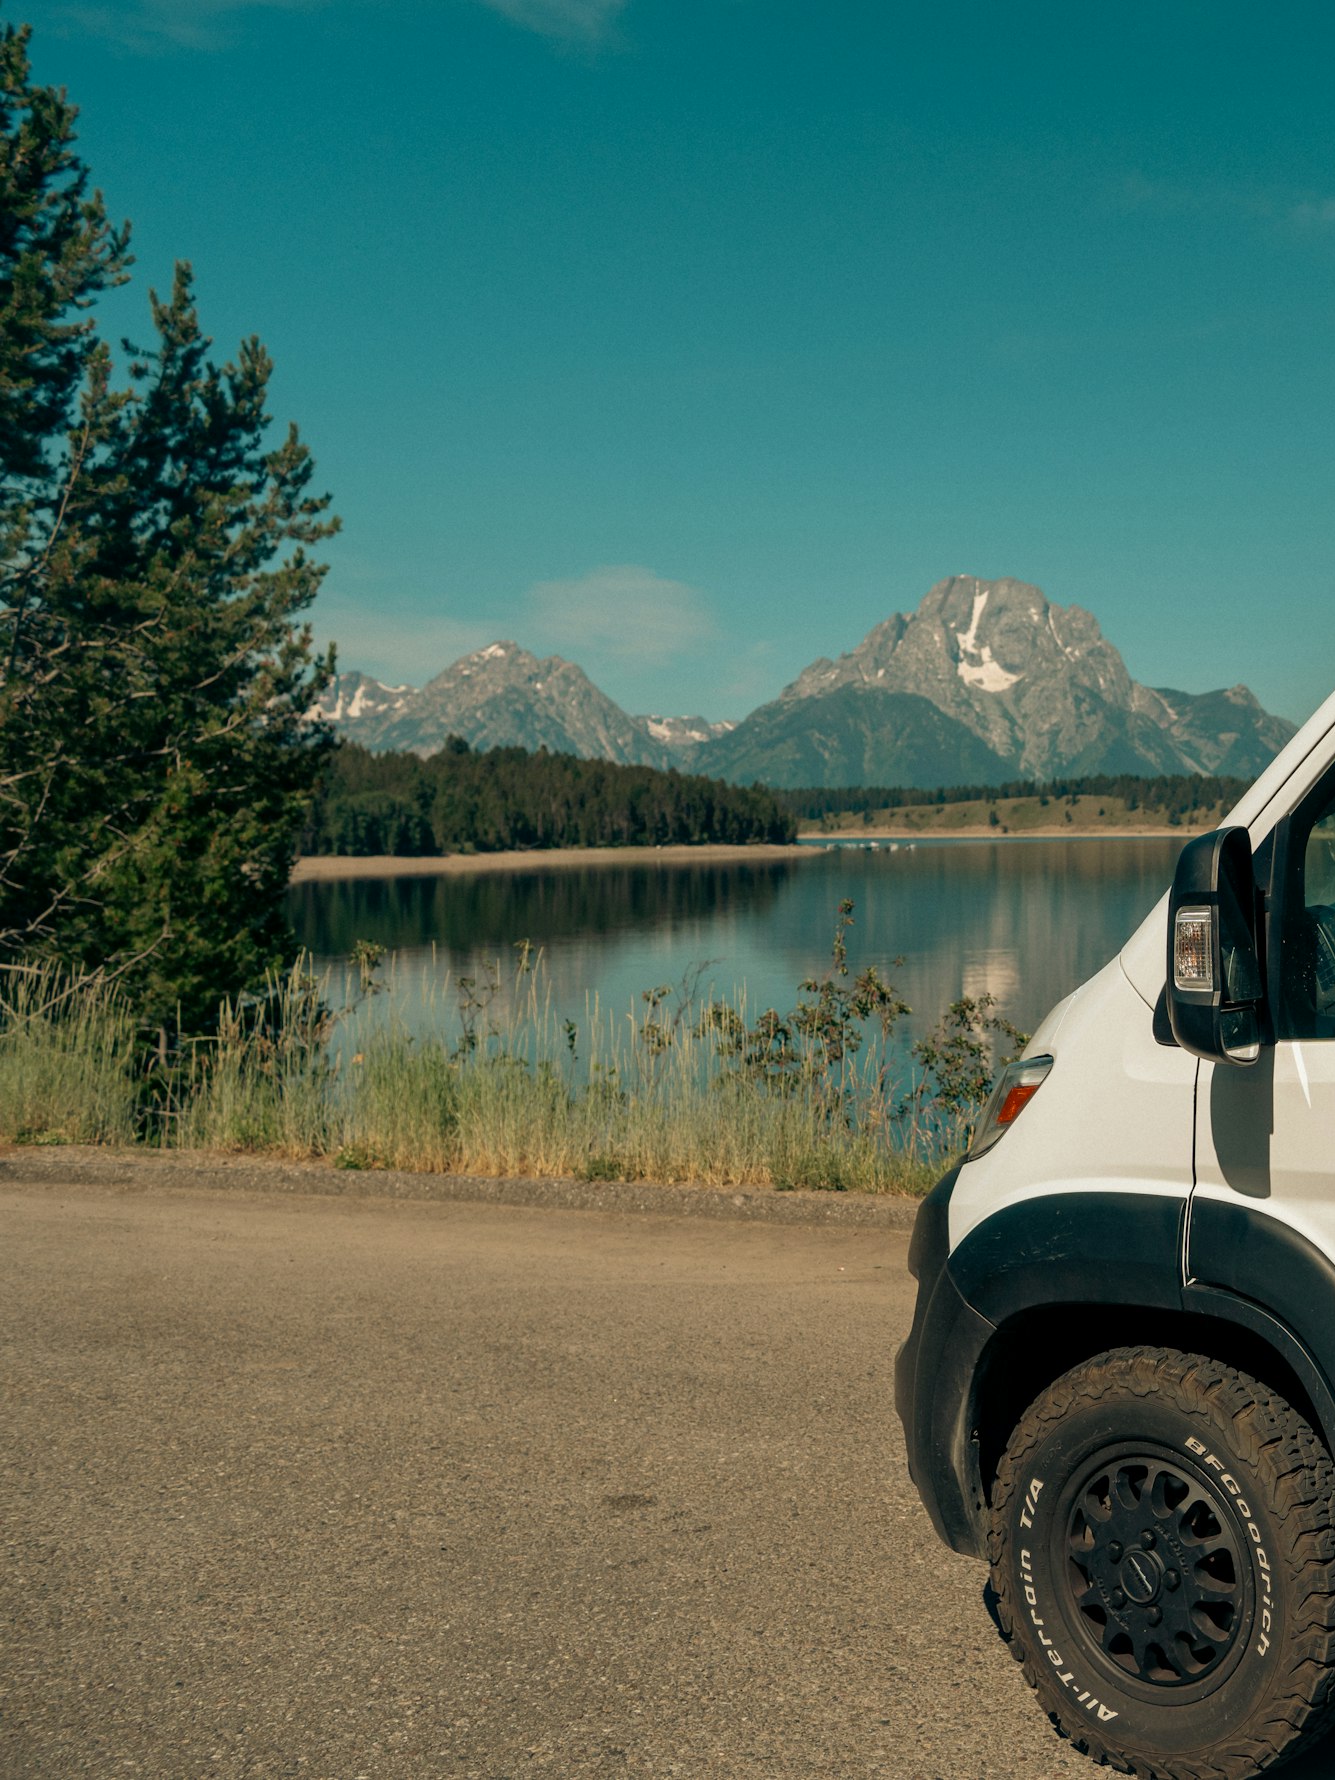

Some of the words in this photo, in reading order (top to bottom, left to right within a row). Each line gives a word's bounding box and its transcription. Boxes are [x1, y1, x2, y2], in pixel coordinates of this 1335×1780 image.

[1020, 1477, 1044, 1530] T/A
[1184, 1436, 1273, 1657] BFGoodrich
[1018, 1549, 1119, 1722] All-Terrain
